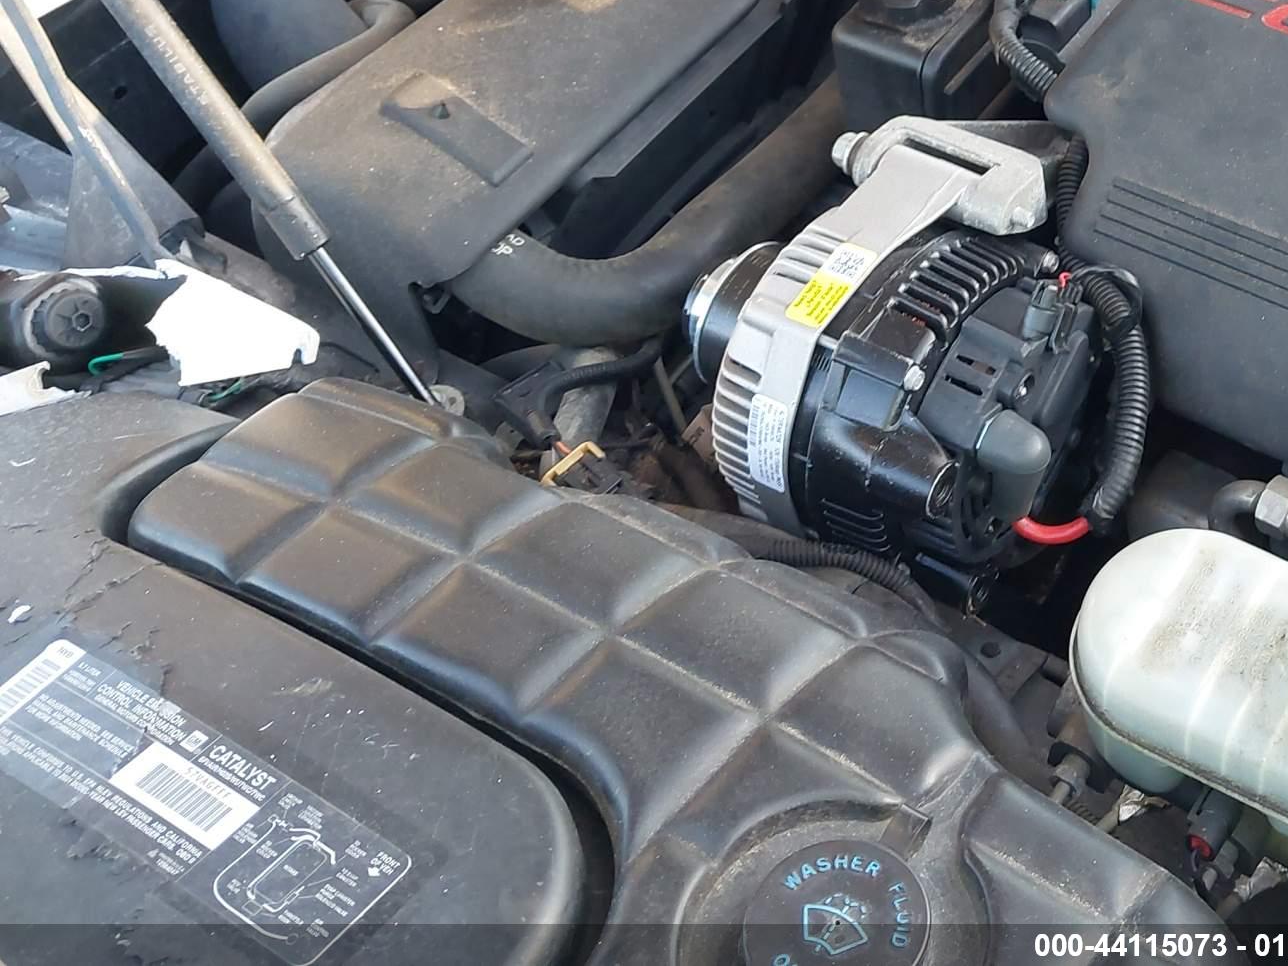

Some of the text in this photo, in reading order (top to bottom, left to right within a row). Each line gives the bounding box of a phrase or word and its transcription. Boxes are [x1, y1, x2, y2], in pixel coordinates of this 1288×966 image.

[97, 684, 187, 742] CONTROL INFORMATION
[116, 681, 150, 705] VEHICLE
[209, 745, 277, 790] CATALYST
[111, 794, 152, 823] REGULATIONS
[151, 819, 167, 834] AND
[165, 829, 201, 858] CALIFORNIA
[370, 856, 394, 875] OF VEH
[377, 850, 401, 869] FRONT
[783, 854, 909, 948] WASHER FLUID
